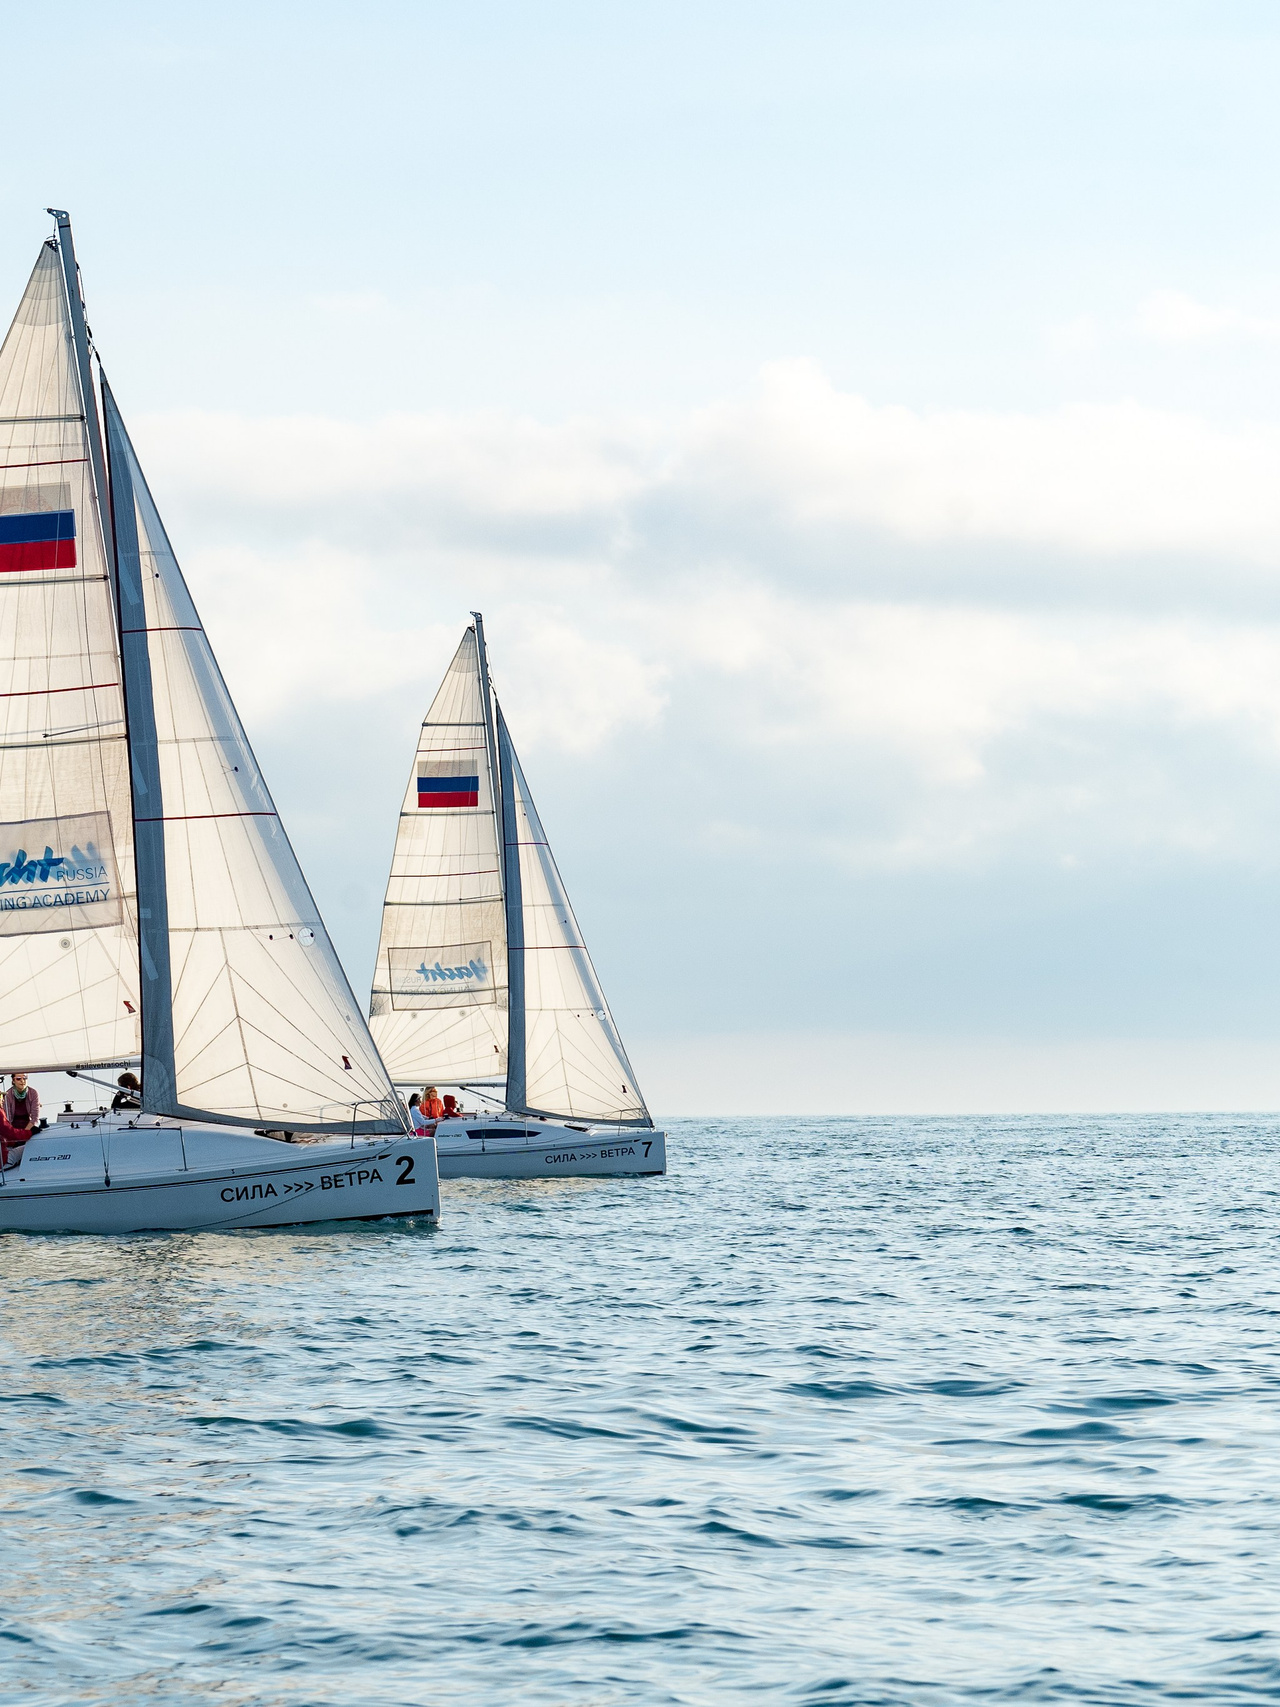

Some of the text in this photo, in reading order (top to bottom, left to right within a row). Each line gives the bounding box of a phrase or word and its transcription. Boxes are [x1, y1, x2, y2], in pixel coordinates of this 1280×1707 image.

[56, 866, 108, 882] RUSSIA
[32, 888, 110, 908] ACADEMY
[545, 1141, 653, 1164] СИЛА ВЕТРА 7
[220, 1155, 416, 1202] СИЛА ВЕТРА 2
